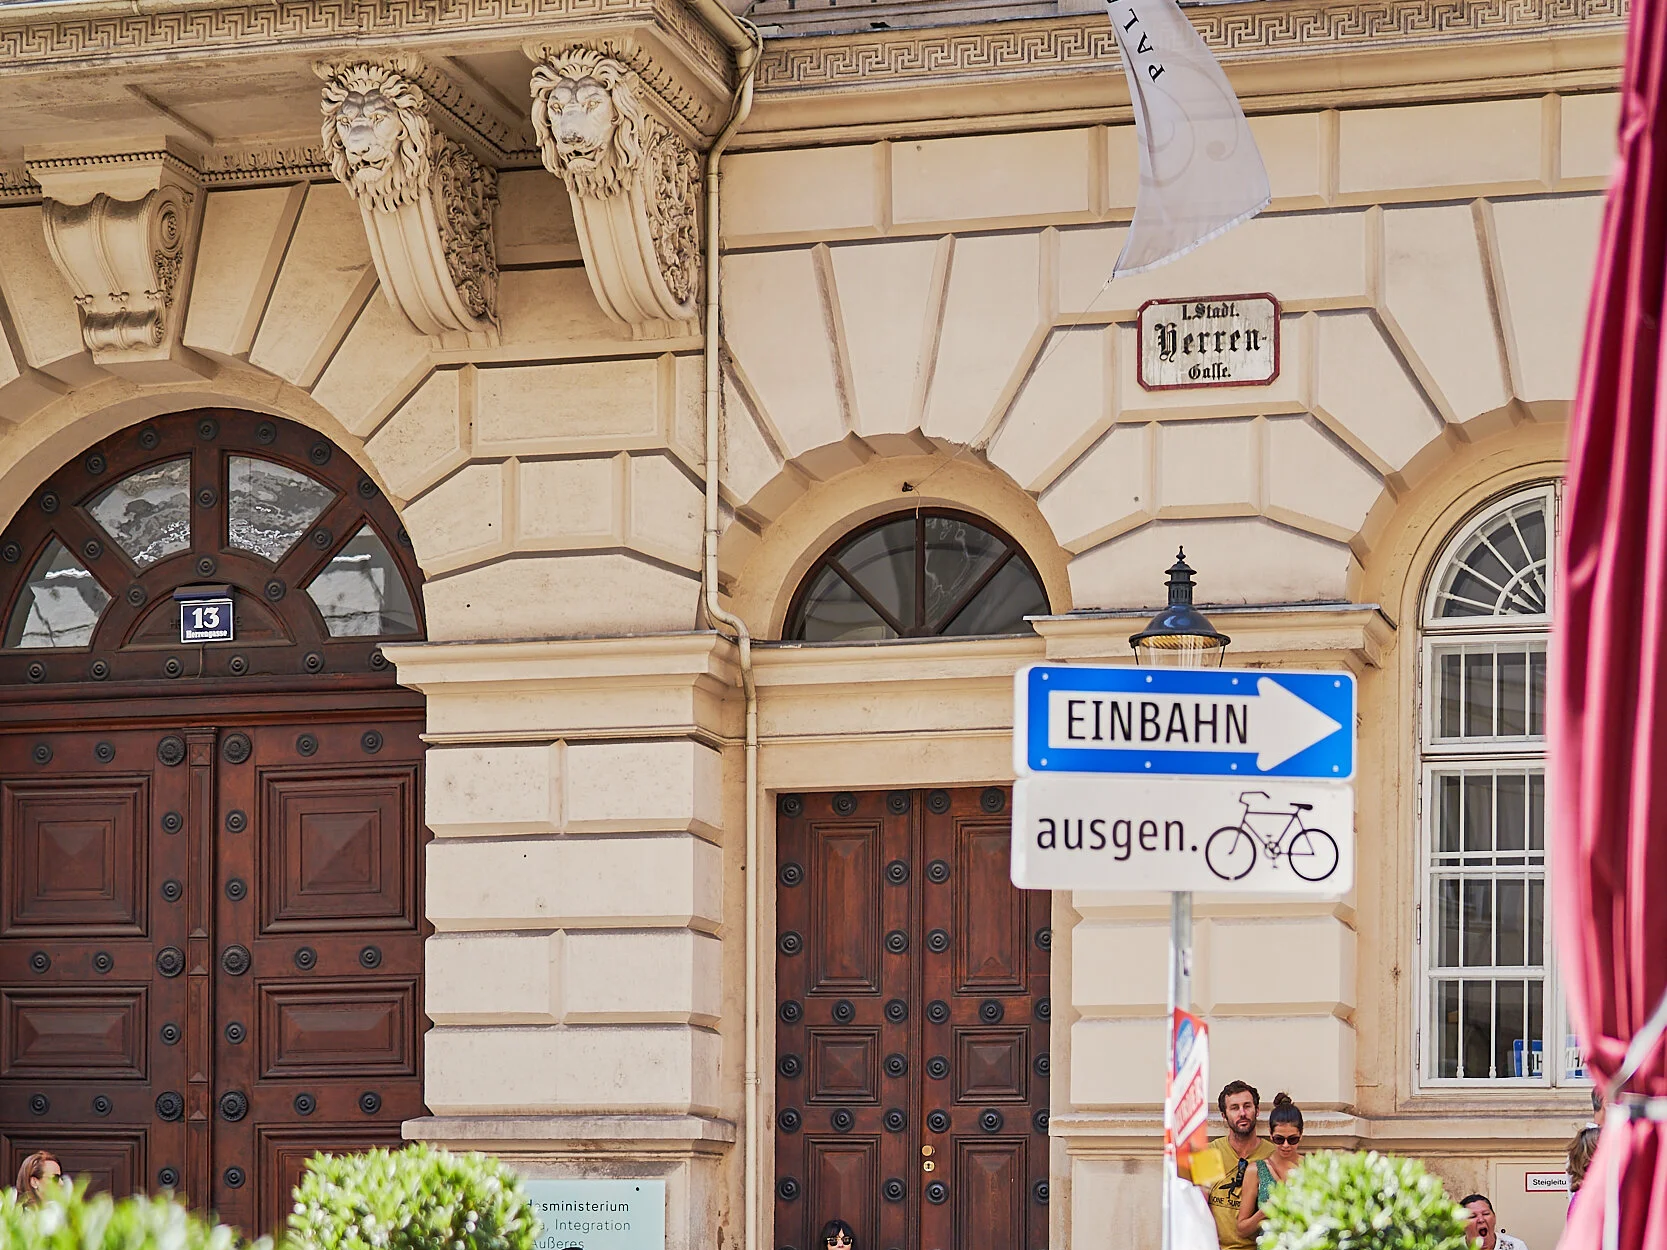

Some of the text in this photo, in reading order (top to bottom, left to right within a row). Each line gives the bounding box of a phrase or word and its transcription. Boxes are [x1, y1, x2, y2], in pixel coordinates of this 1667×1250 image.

[1107, 0, 1165, 83] PAL
[185, 629, 228, 638] Herrengasse
[192, 607, 220, 629] 13
[1067, 700, 1248, 744] EINBAHN
[1036, 817, 1198, 861] ausgen.
[555, 1218, 631, 1234] Integration
